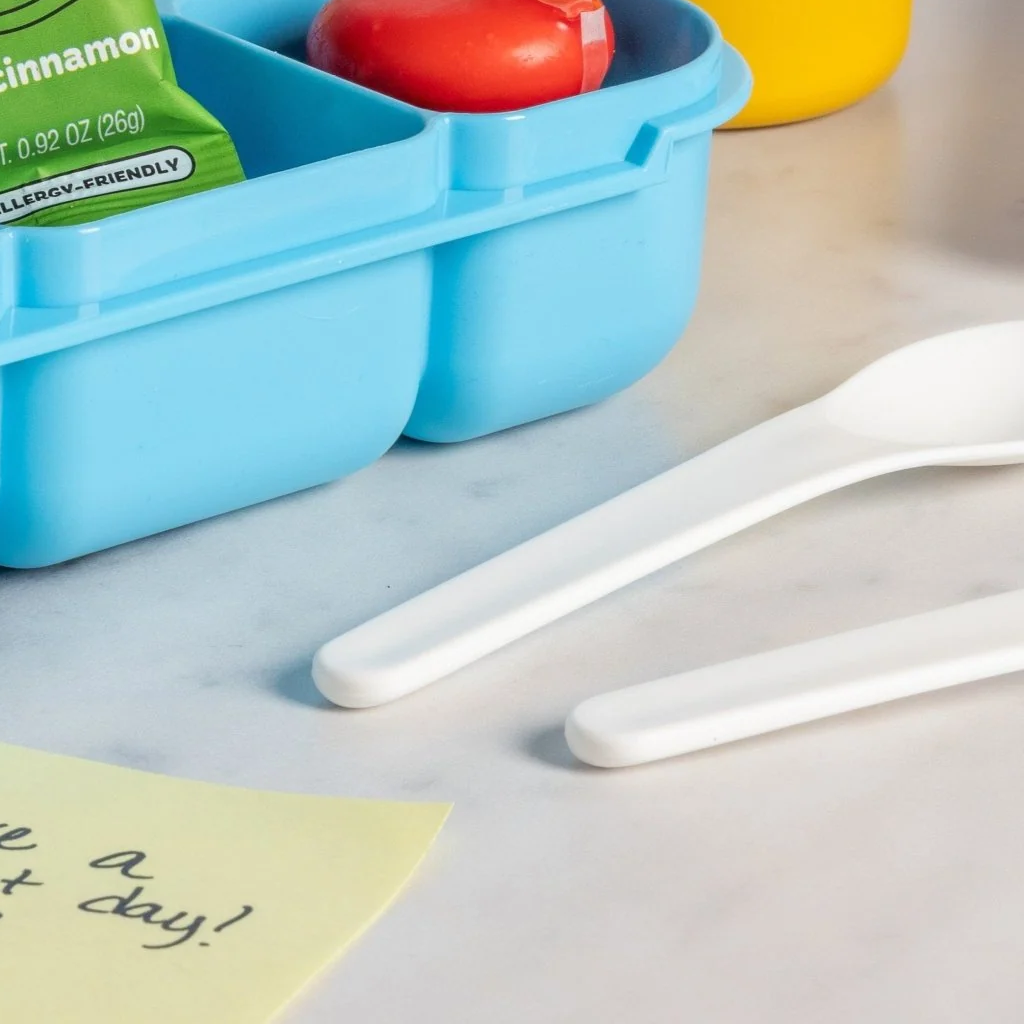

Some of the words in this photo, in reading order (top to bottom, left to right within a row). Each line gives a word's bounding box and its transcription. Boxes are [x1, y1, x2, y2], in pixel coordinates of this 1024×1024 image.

[17, 128, 61, 160] 0.92
[65, 119, 93, 146] OZ
[97, 103, 145, 142] (26g)
[88, 850, 155, 880] a
[77, 886, 254, 950] day!
